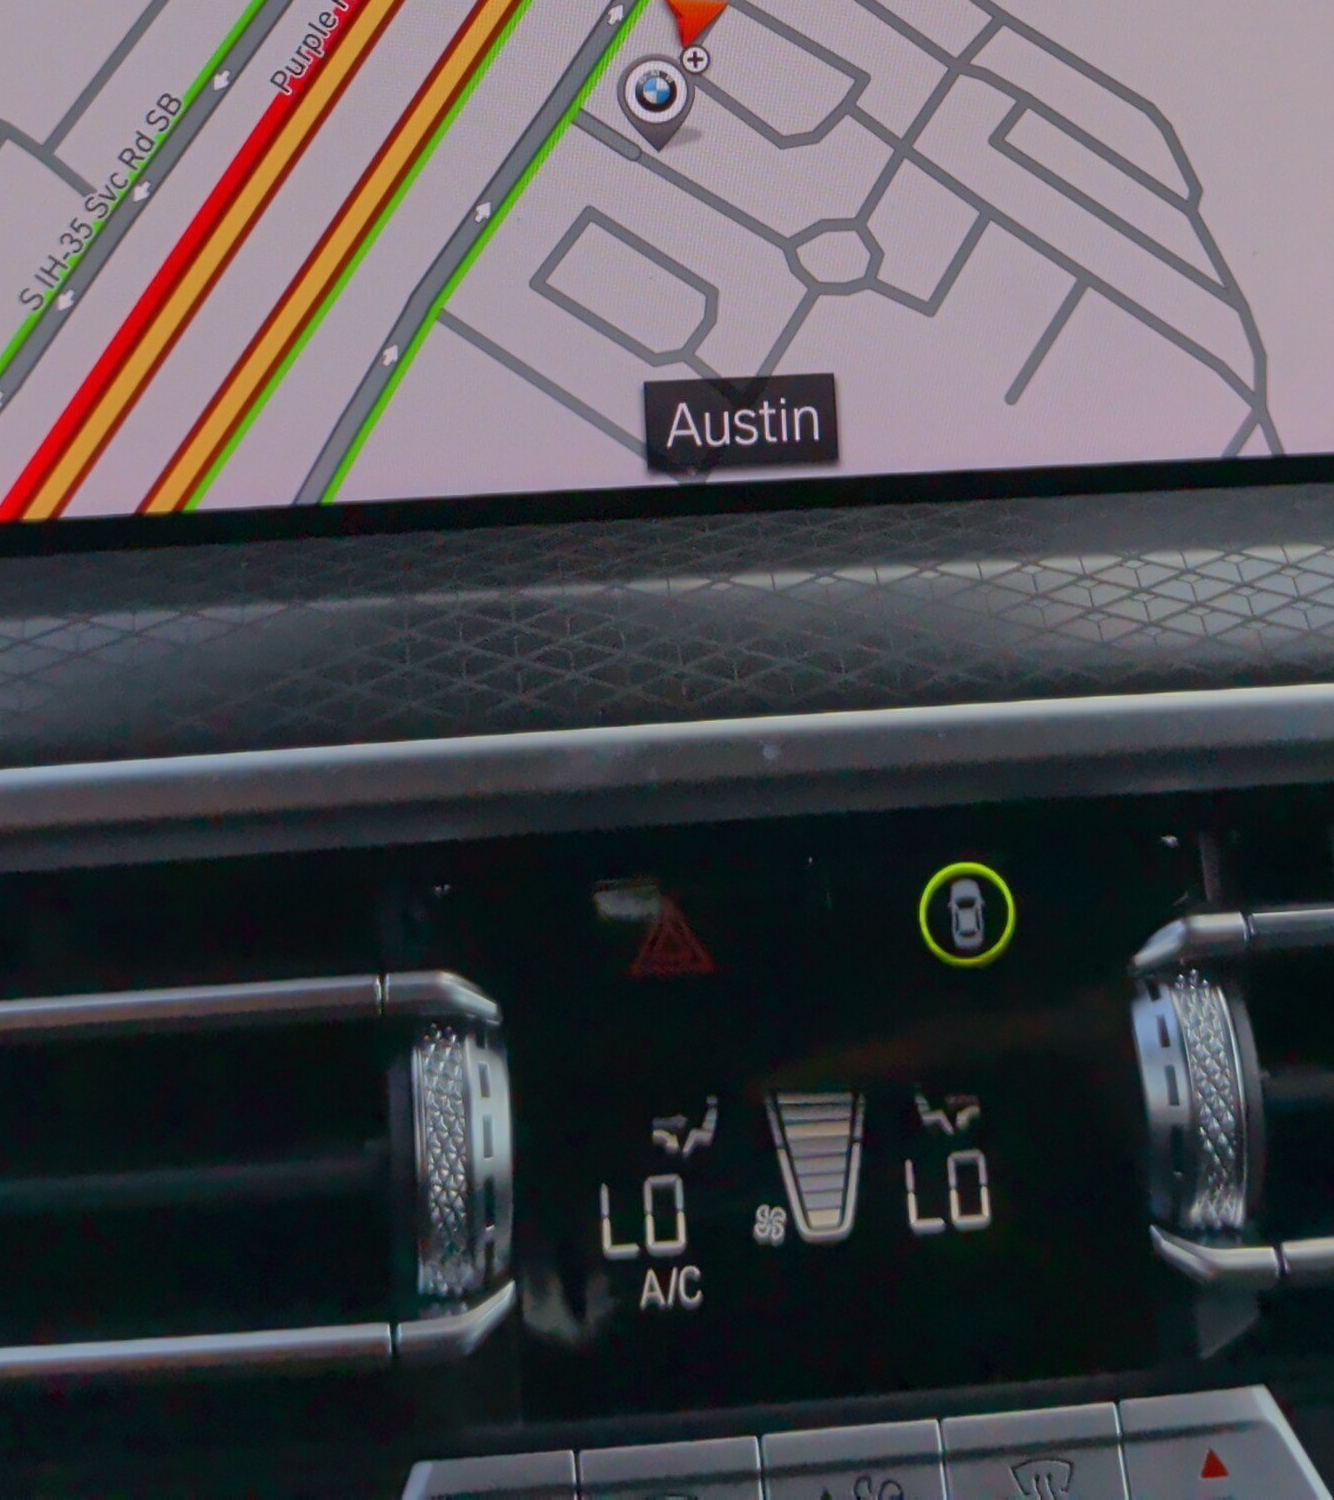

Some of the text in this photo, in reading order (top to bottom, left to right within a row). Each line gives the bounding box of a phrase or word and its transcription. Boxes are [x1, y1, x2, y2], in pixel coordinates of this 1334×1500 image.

[270, 11, 337, 93] Purple
[19, 92, 183, 312] S IH-35 Svc Rd SB
[667, 397, 820, 448] Austin
[599, 1173, 687, 1260] LO
[904, 1148, 992, 1235] LO
[639, 1265, 704, 1310] A/C
